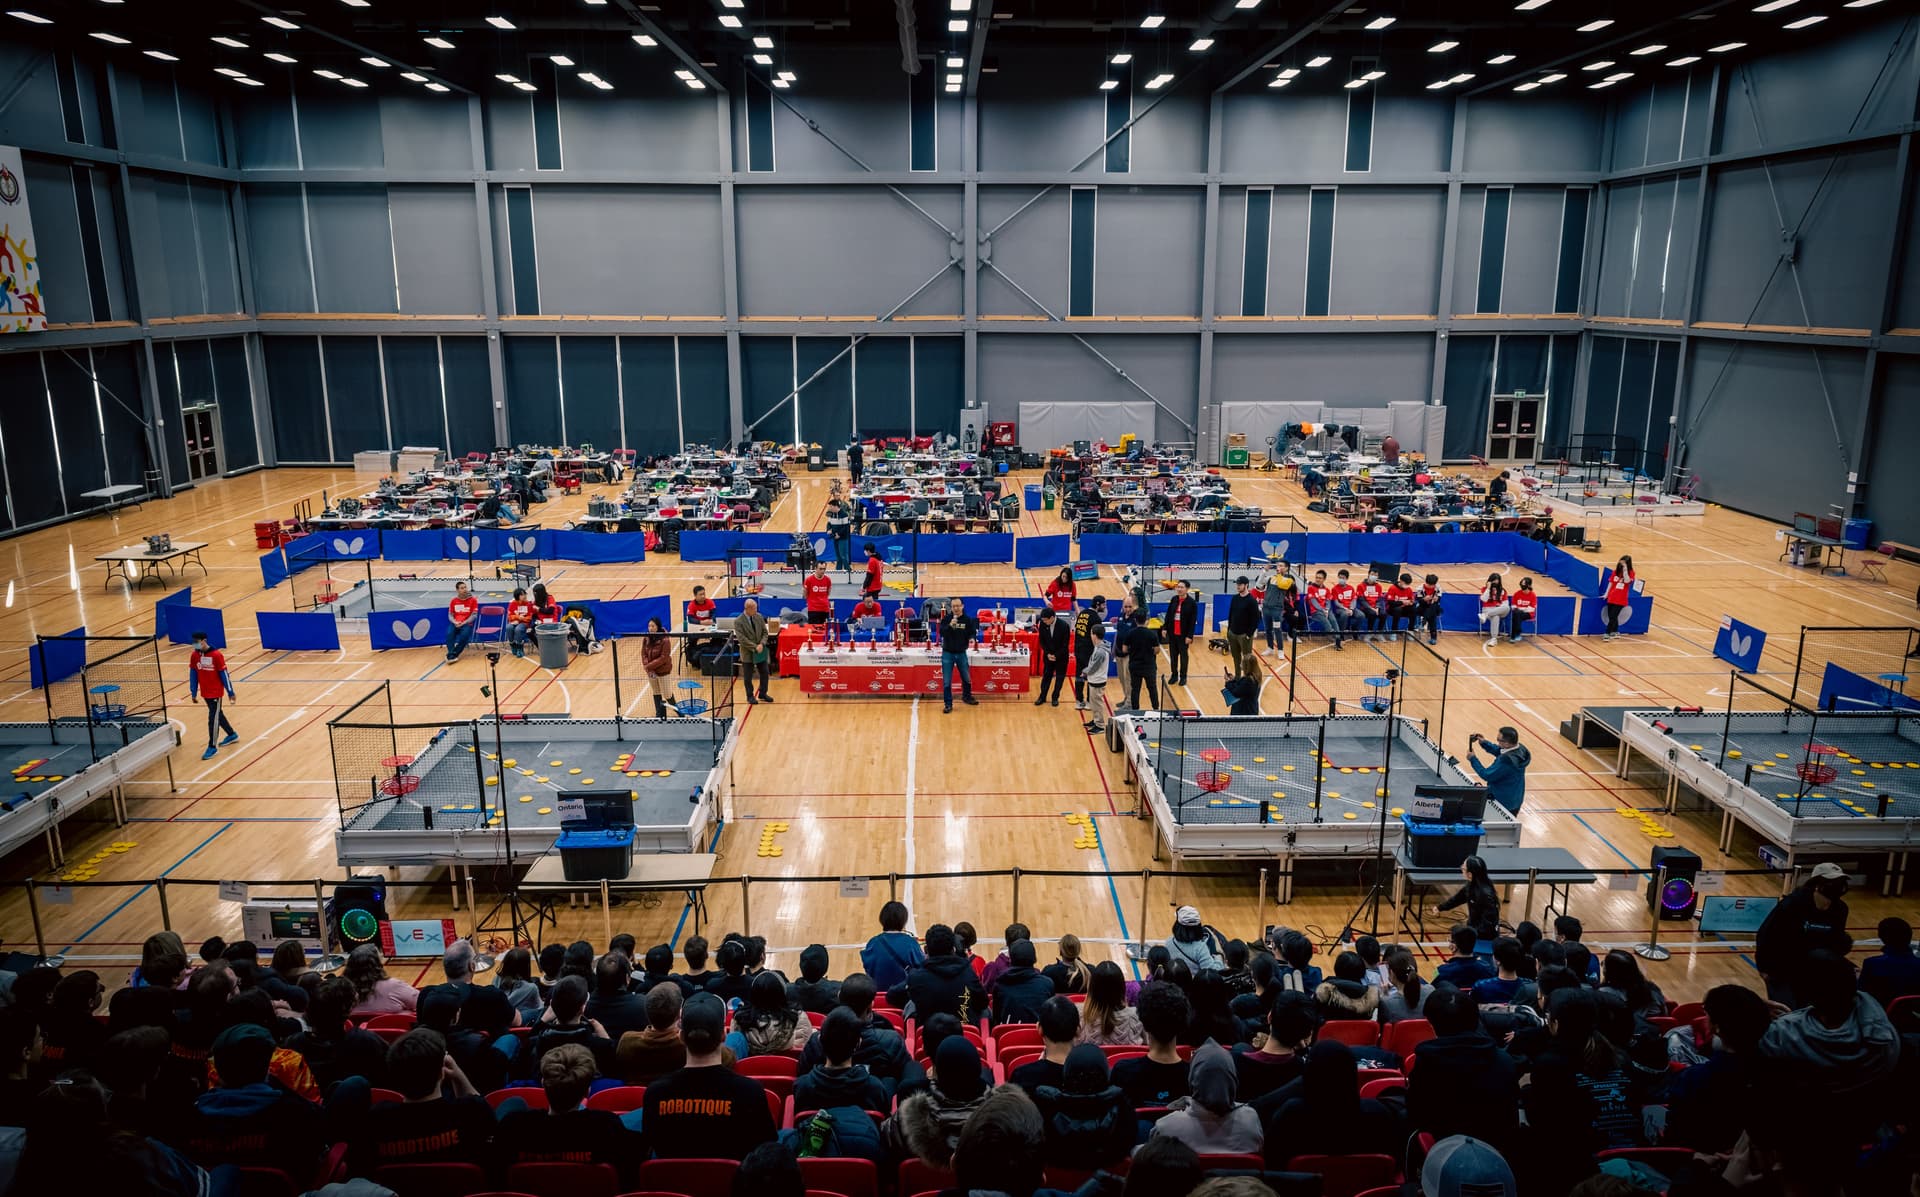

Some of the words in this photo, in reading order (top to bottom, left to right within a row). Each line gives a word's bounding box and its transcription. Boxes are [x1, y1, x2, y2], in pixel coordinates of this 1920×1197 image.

[557, 804, 584, 812] Ontario
[1415, 800, 1441, 808] Alberta
[1719, 899, 1761, 912] VEX
[395, 929, 441, 943] VEX
[659, 1098, 733, 1116] ROBOTIQUE
